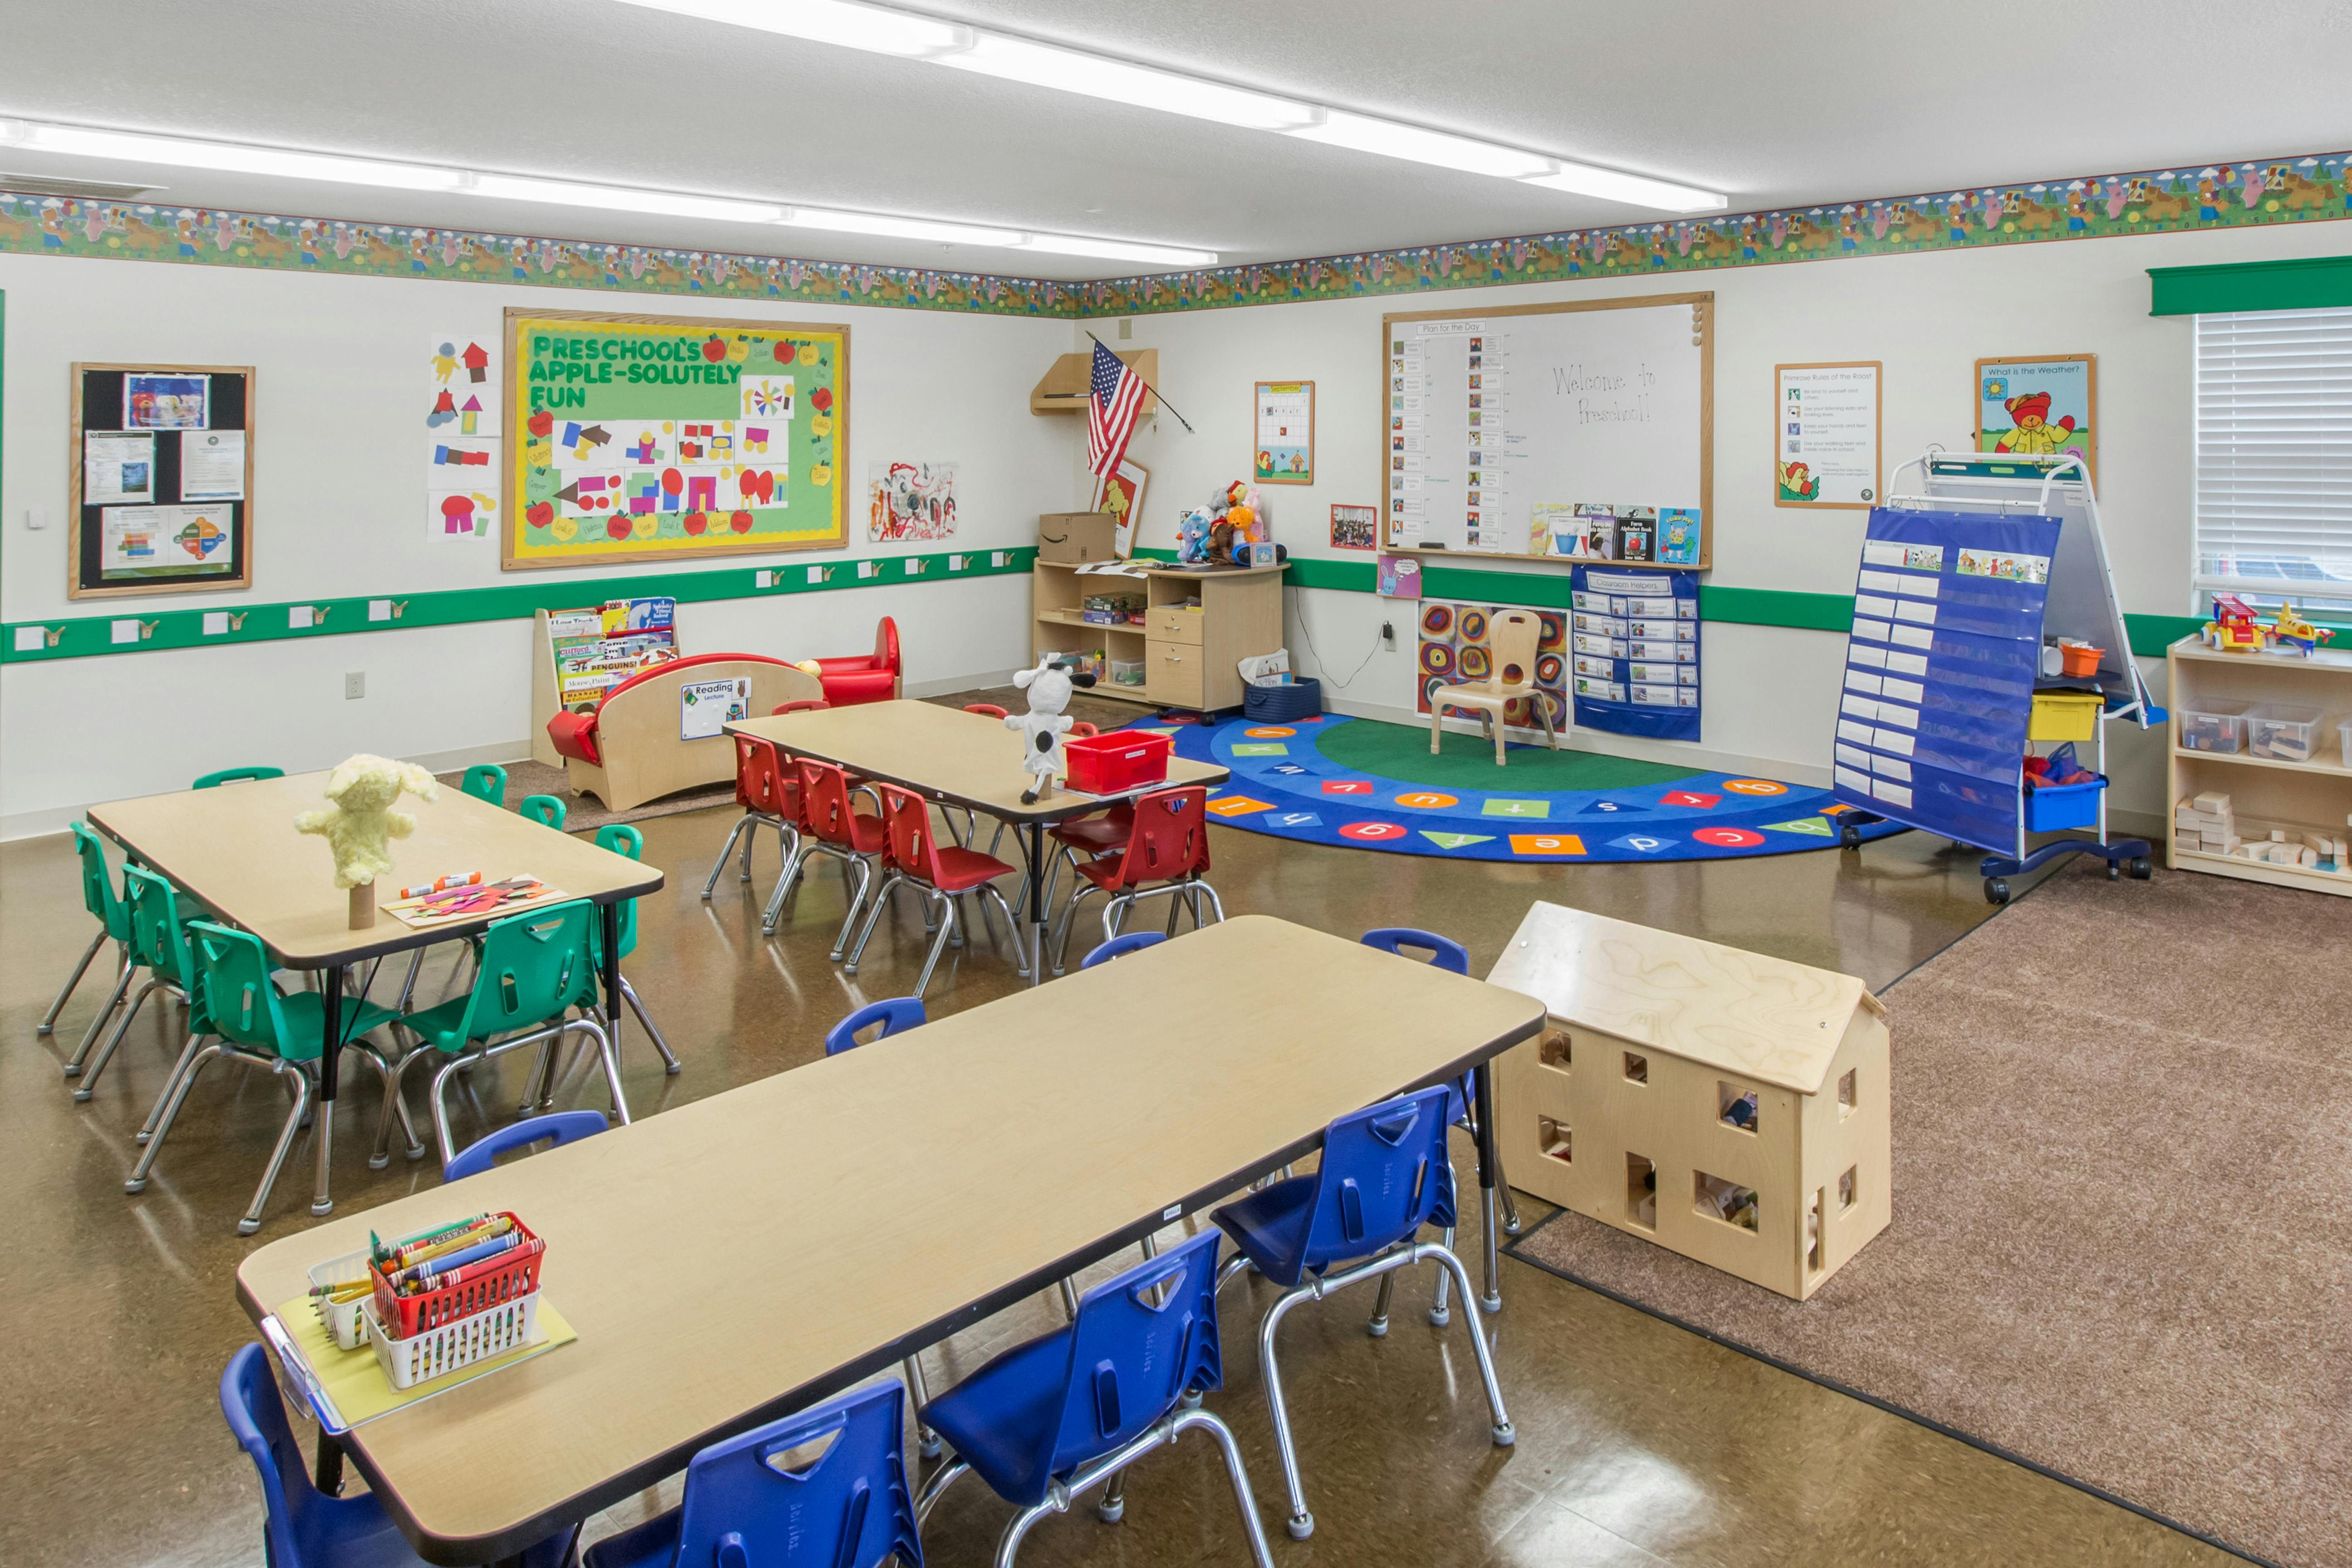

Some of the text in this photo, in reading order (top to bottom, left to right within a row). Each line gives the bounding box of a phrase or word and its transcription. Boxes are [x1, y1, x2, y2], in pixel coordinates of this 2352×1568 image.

[1423, 323, 1480, 333] Plan for the Day
[534, 336, 701, 363] PRESCHOOL'S
[529, 361, 743, 385] APPLE-SOLUTELY
[2037, 366, 2079, 374] Weather?
[1553, 363, 1656, 394] Welcome to
[530, 387, 585, 408] FUN
[1579, 393, 1650, 424] Preschool!
[1596, 578, 1657, 590] Classroom Helpers
[559, 646, 589, 656] Clifford
[591, 661, 637, 671] PENGUINS!
[696, 683, 733, 695] Reading
